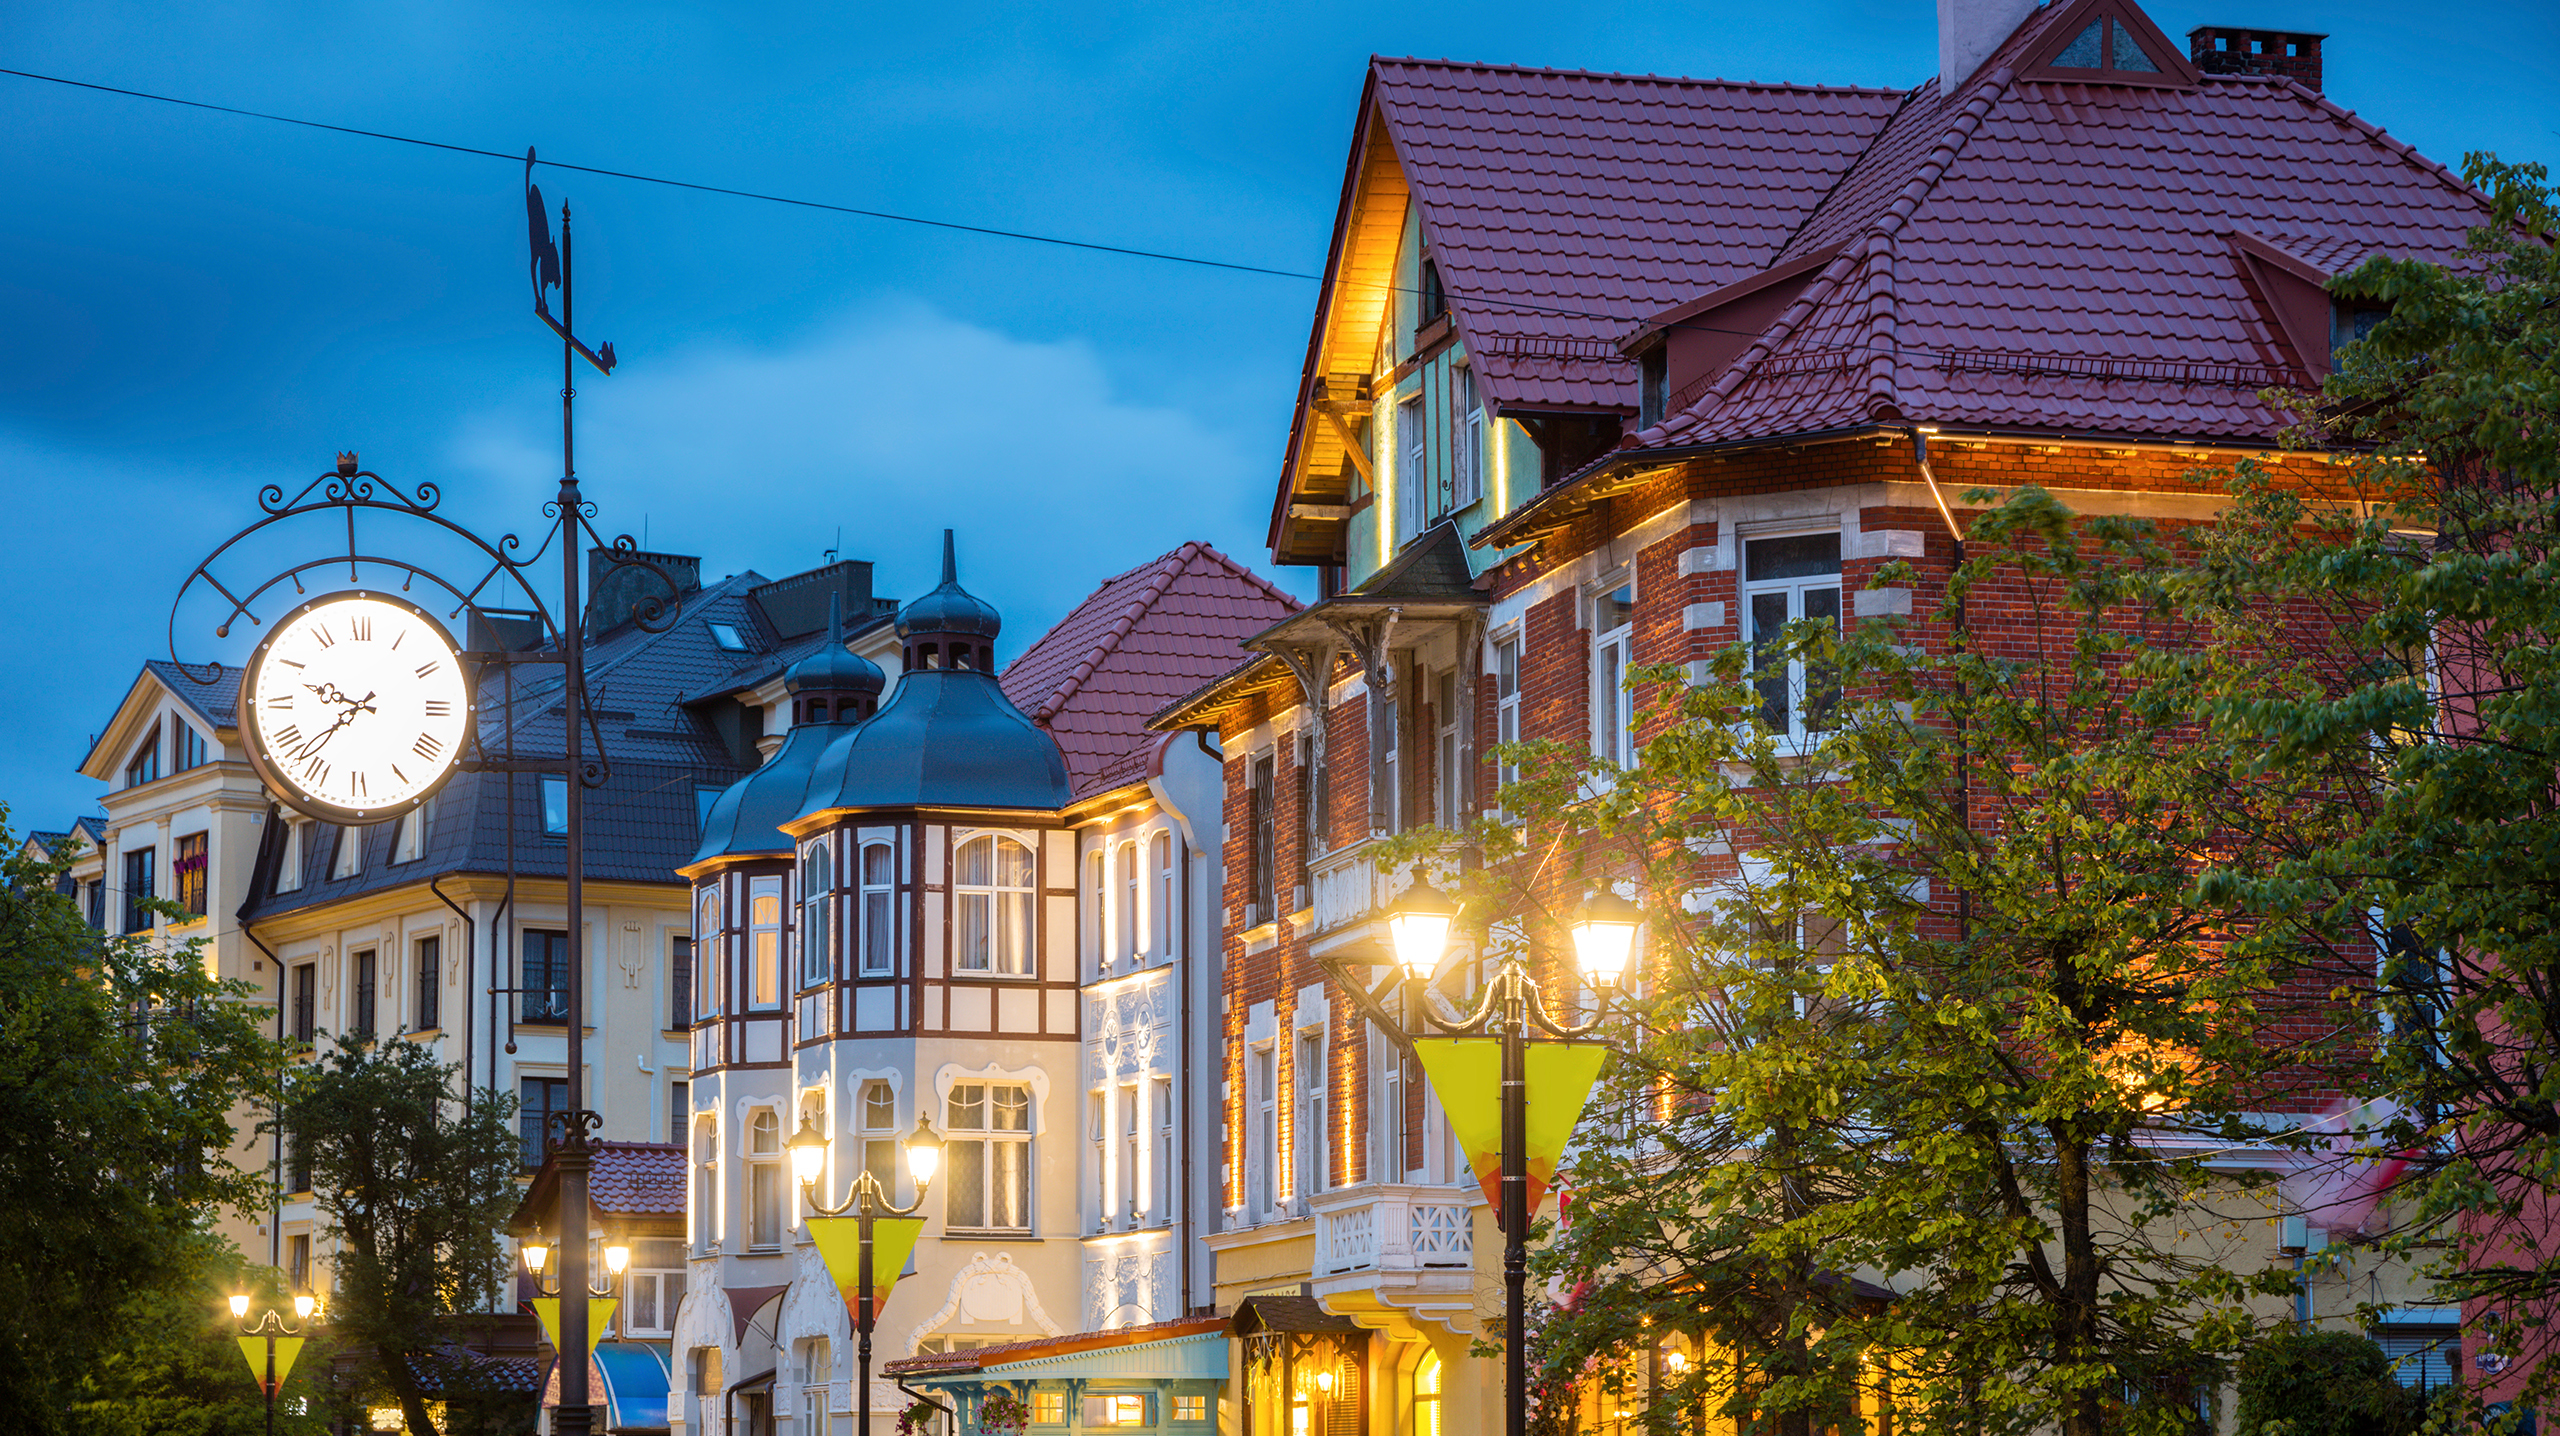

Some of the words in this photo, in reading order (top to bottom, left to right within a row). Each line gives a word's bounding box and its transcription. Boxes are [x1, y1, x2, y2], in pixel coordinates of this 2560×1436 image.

[391, 629, 407, 651] I
[414, 660, 441, 680] II
[425, 699, 451, 717] III
[411, 731, 445, 763] IIII
